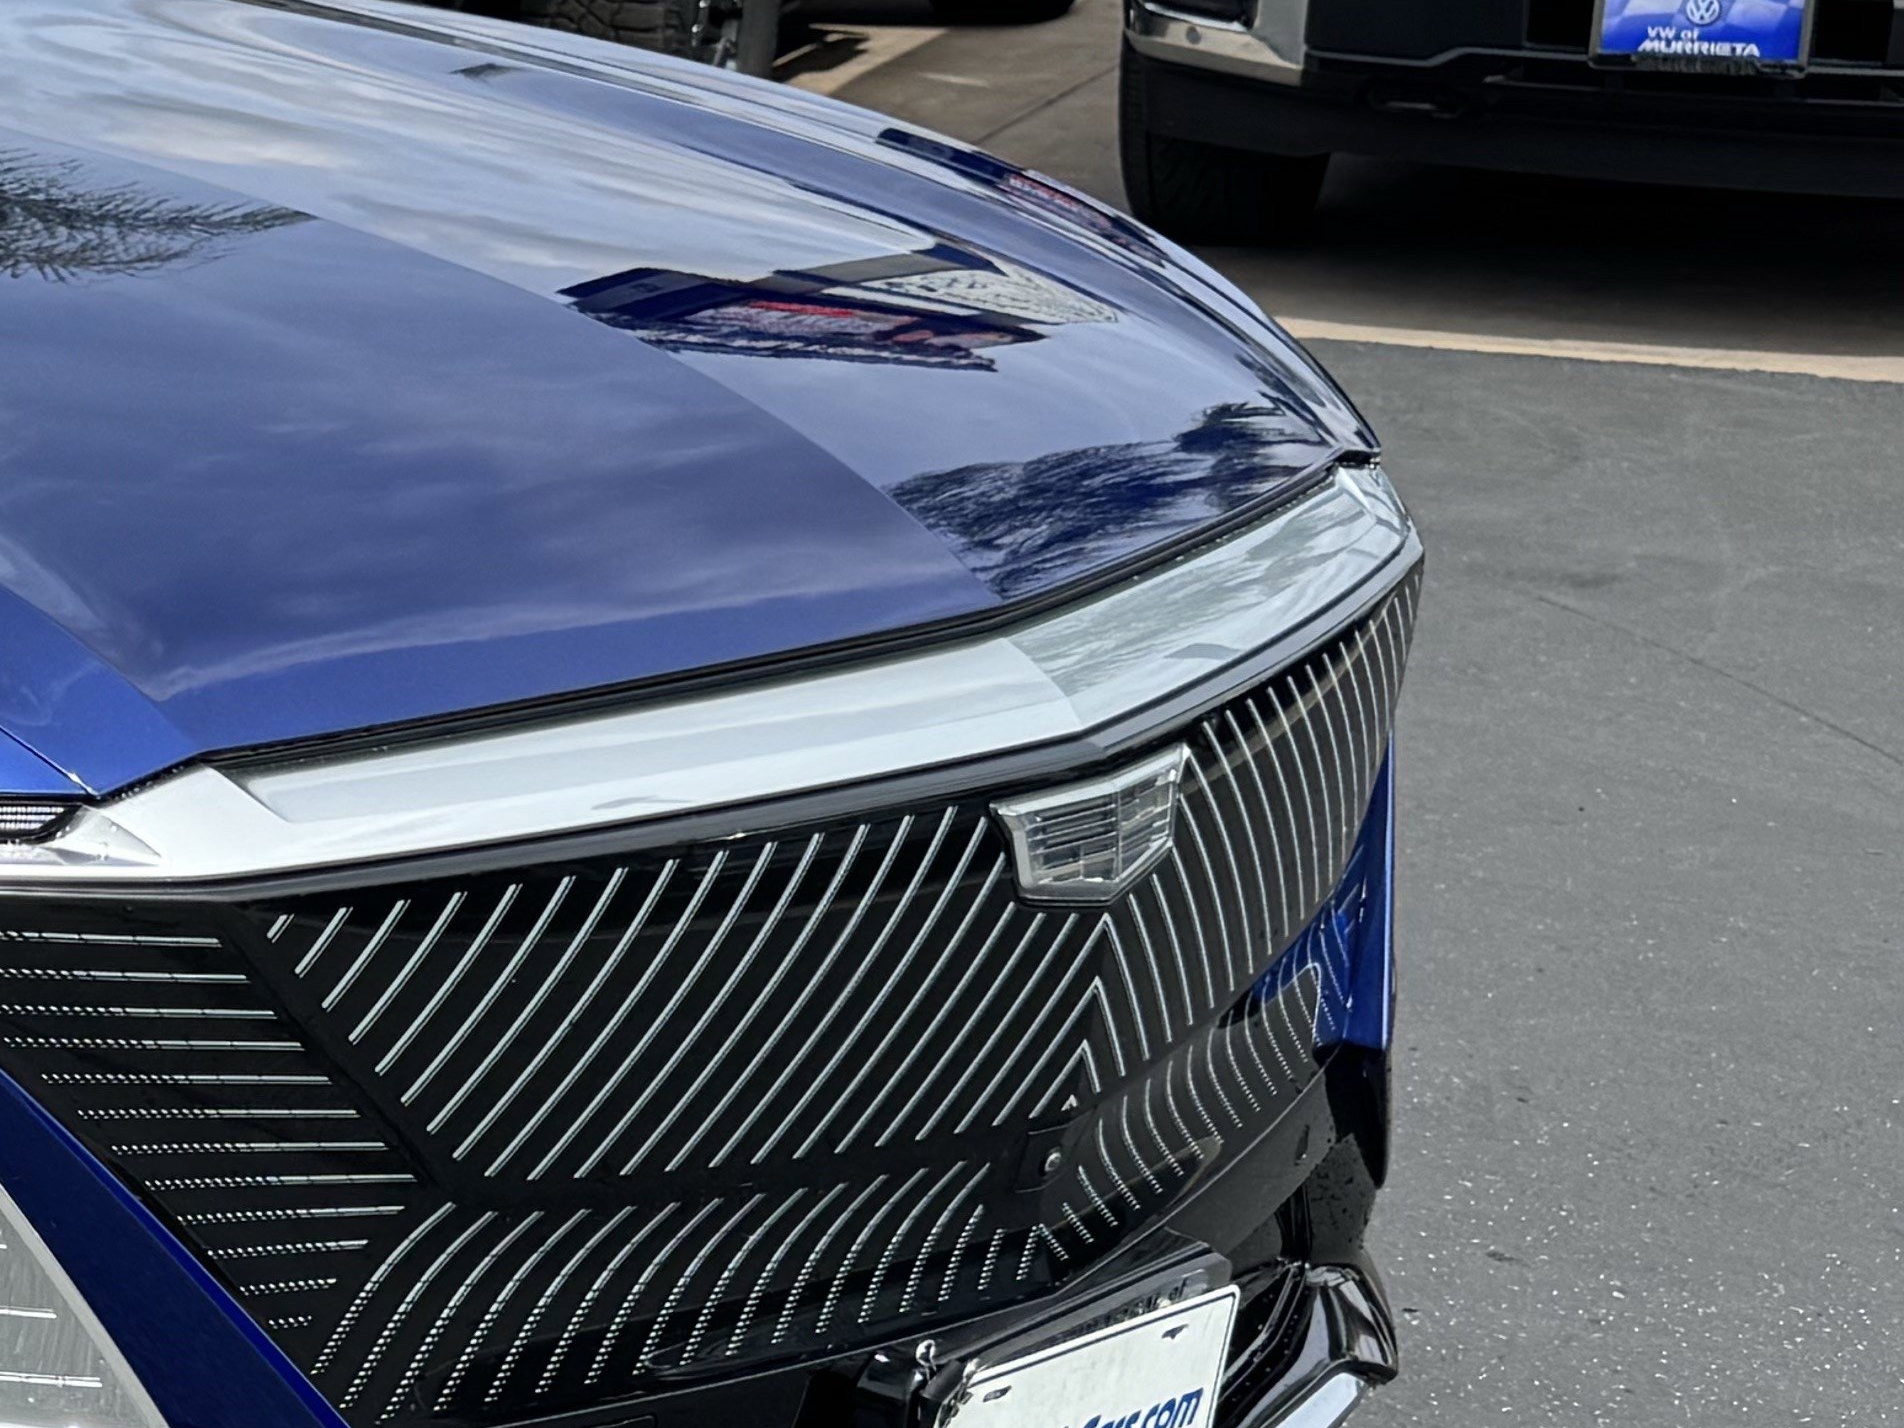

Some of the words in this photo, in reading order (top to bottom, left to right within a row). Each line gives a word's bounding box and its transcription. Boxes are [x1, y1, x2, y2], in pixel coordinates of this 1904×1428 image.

[1647, 25, 1676, 39] VW
[1680, 28, 1700, 39] of
[1637, 38, 1761, 58] MURRIETA
